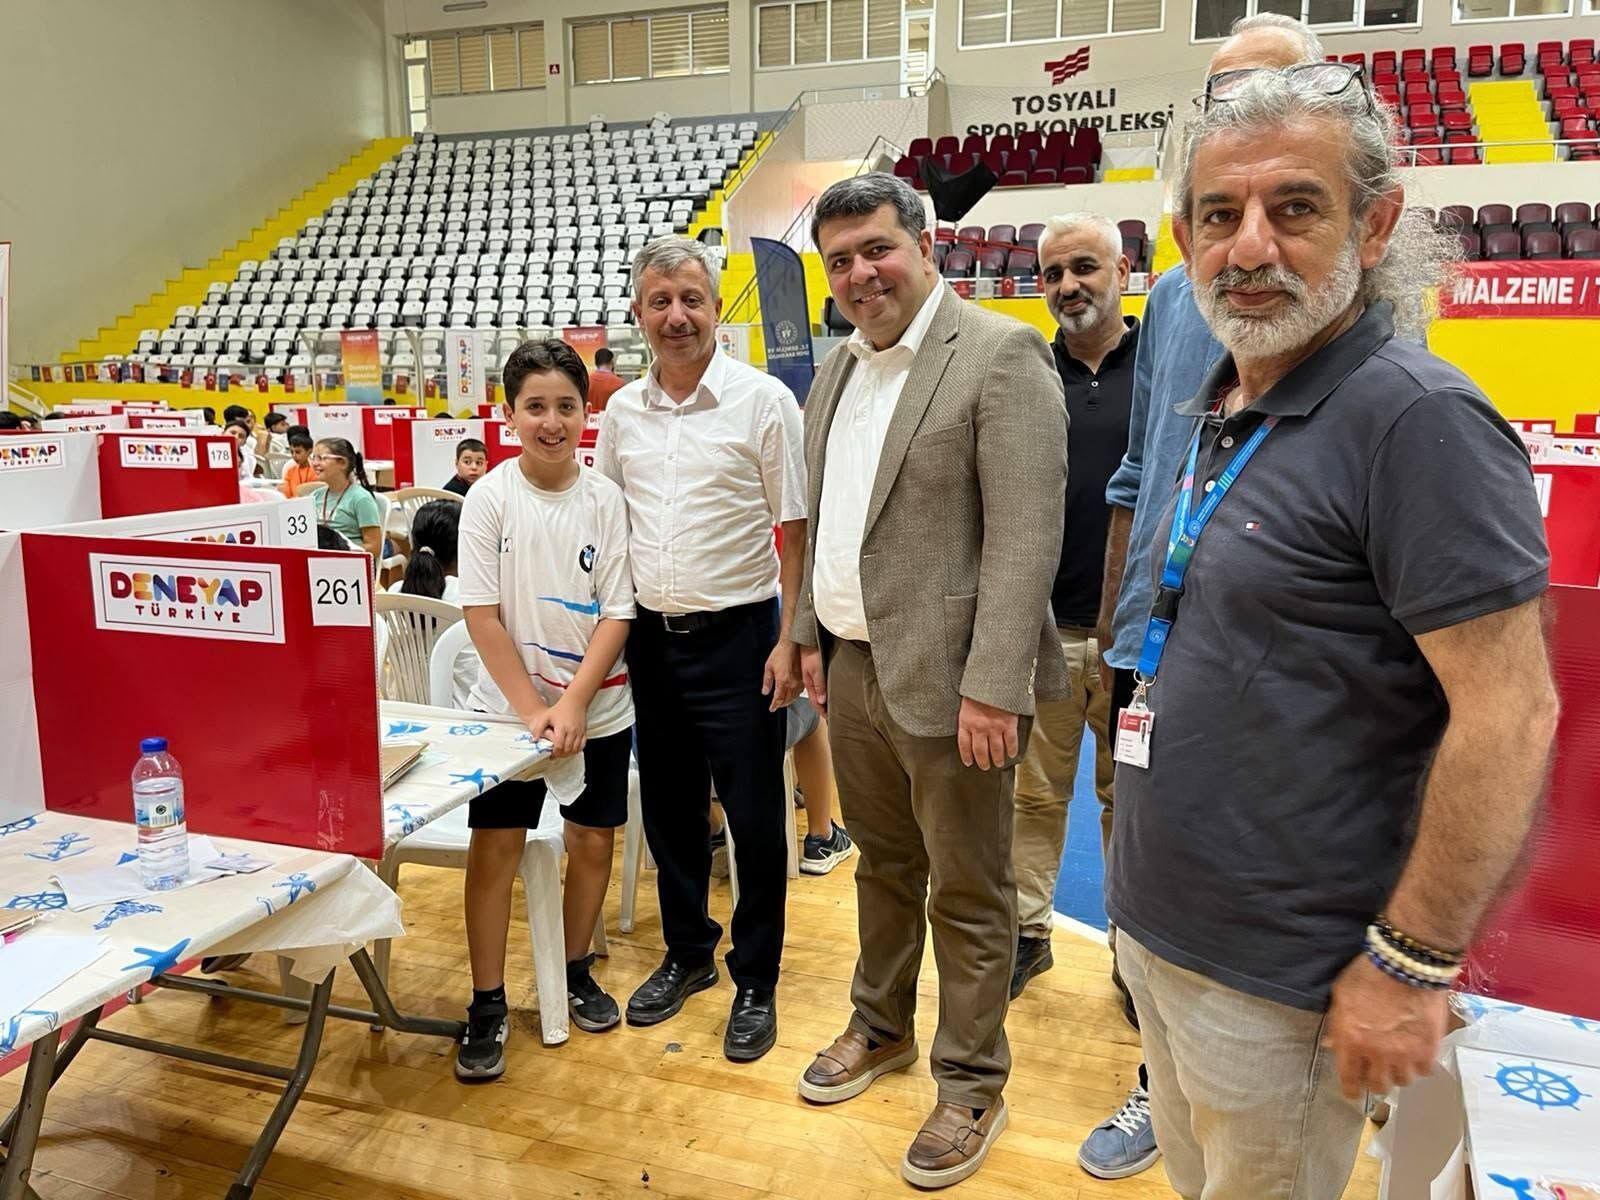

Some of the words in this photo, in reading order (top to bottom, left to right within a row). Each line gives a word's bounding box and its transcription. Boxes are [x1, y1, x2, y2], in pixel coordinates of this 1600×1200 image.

[1012, 88, 1116, 115] TOSYALI
[967, 120, 1028, 138] SPOR
[1453, 277, 1575, 305] MALZEME
[0, 444, 57, 460] ENEYAP
[128, 443, 189, 456] DENEYAP
[211, 449, 230, 462] 178
[287, 514, 308, 536] 33
[110, 571, 263, 608] DENEYAP
[315, 578, 363, 606] 261
[135, 603, 241, 623] TÜRKİYE
